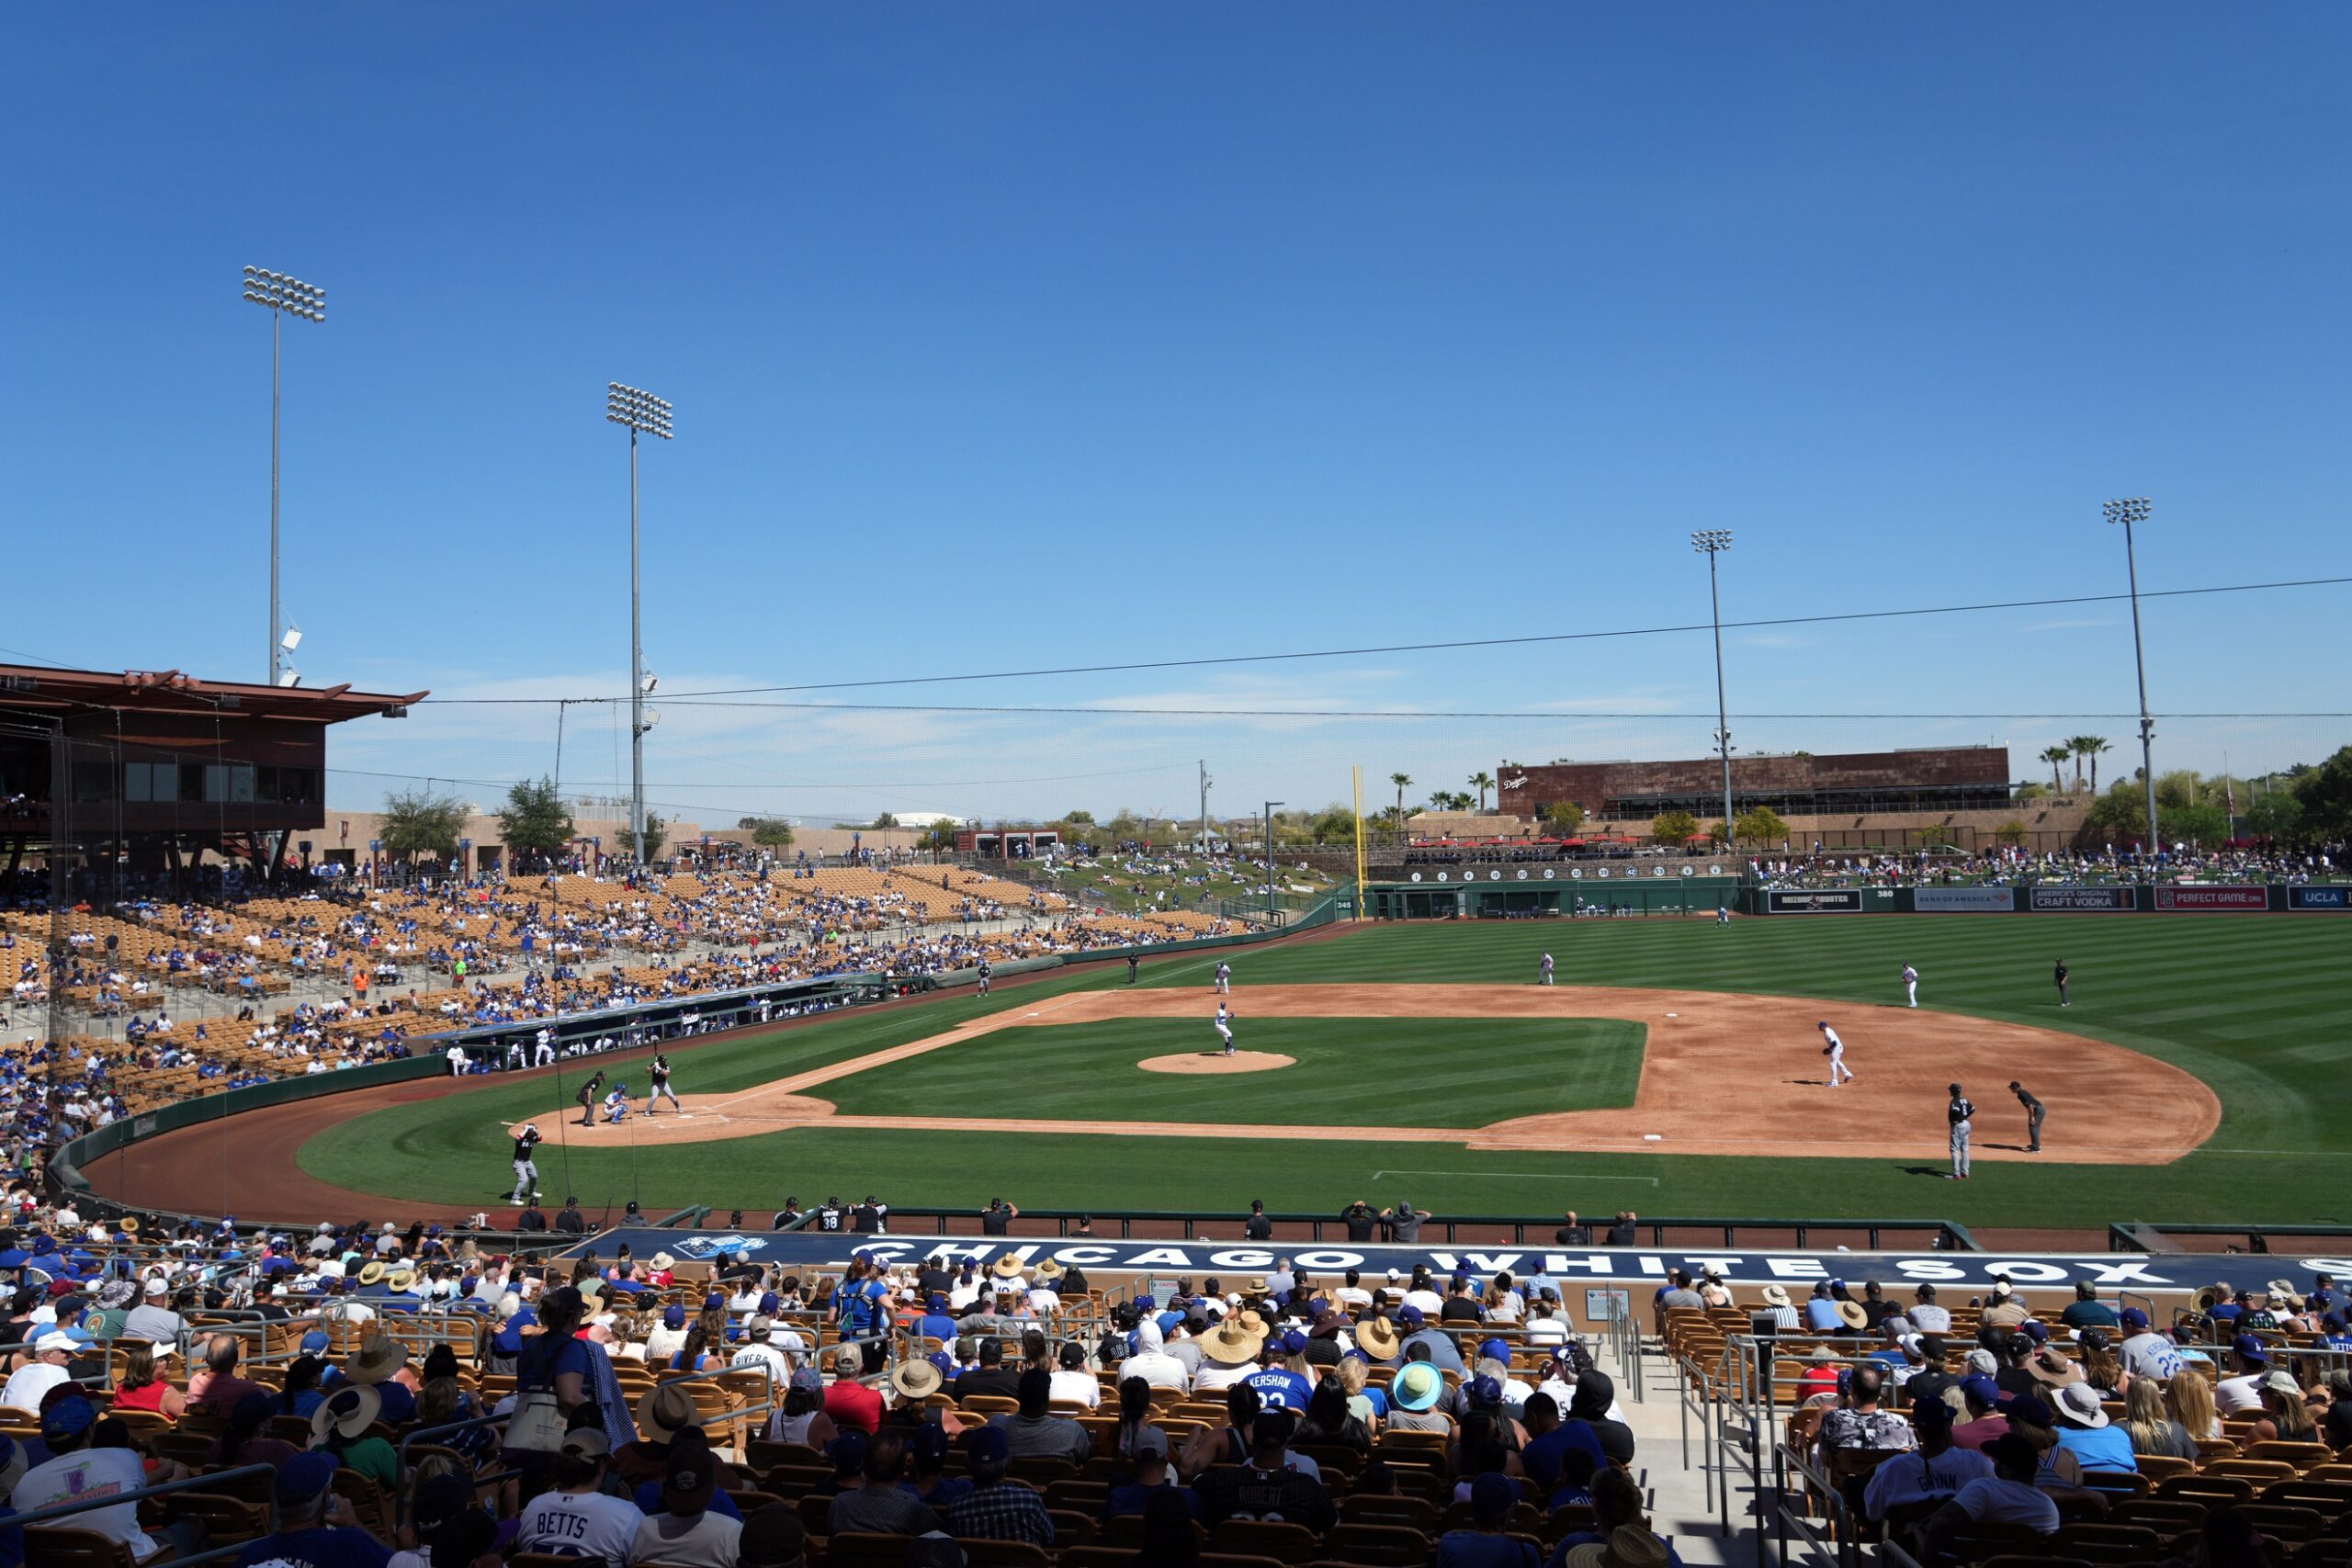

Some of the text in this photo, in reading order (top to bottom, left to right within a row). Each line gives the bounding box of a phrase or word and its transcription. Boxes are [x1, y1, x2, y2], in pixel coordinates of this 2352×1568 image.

[1503, 775, 1528, 790] Dodgers
[2037, 897, 2112, 907] CRAFT VODKA
[2177, 893, 2216, 903] PERFECT
[2305, 892, 2338, 903] UCLA
[823, 1216, 838, 1229] 38
[851, 1242, 2176, 1283] CHICAGO WHITE SOX
[1250, 1374, 1291, 1389] KERSHAW
[1917, 1474, 1956, 1492] GWYNN
[1238, 1484, 1283, 1507] ROBERT
[537, 1512, 588, 1539] BETTS
